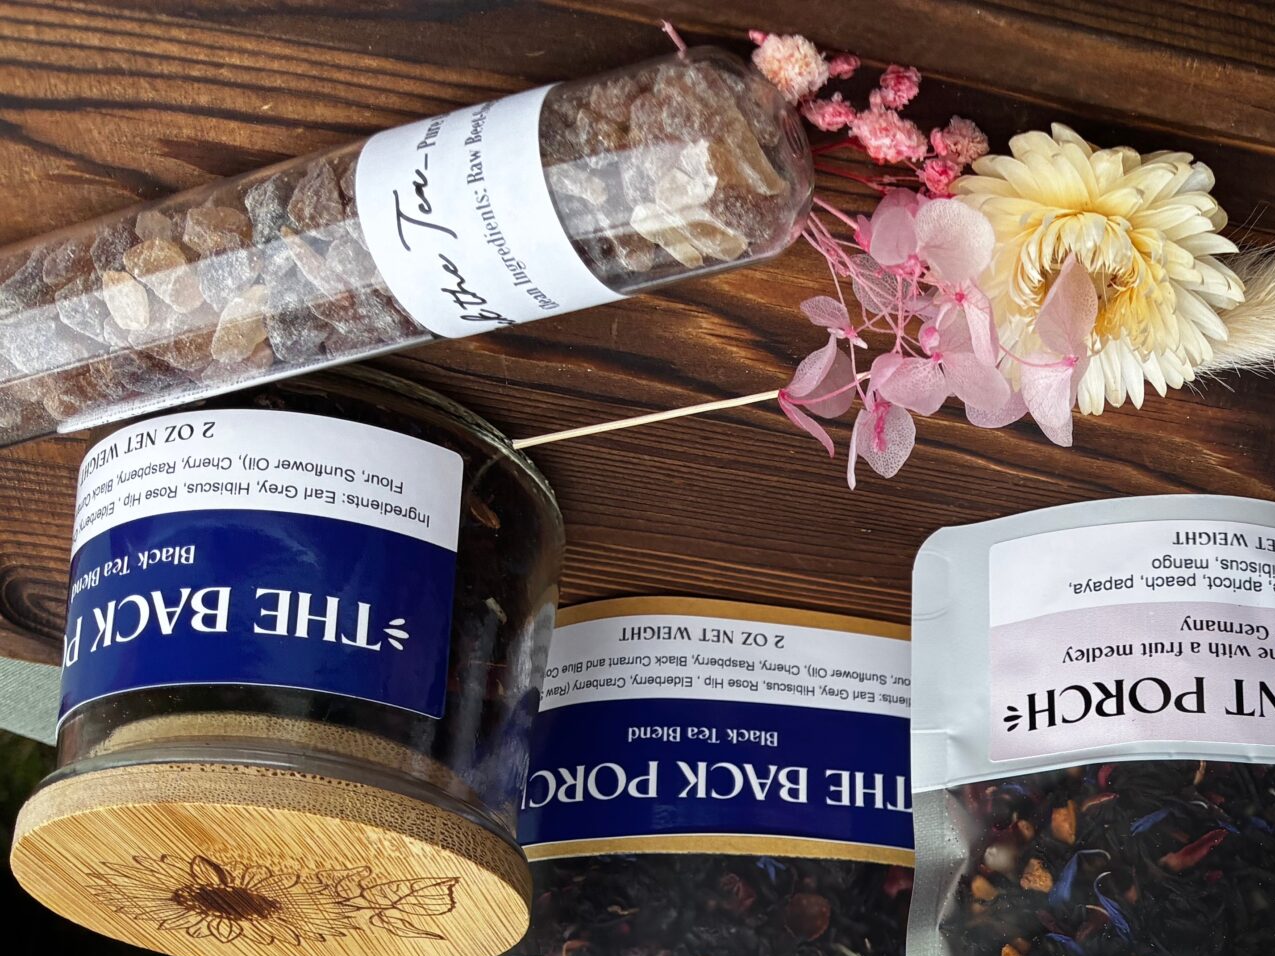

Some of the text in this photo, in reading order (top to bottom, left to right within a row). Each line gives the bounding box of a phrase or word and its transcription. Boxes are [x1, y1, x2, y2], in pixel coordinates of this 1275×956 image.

[466, 148, 485, 185] Raw
[392, 168, 459, 253] Tea
[473, 187, 533, 287] Ingredients:
[79, 421, 216, 486] 2 OZ NET WEIGHT
[92, 454, 404, 501] Flour, Sunflower Oil), Cherry, Raspberry, Black
[123, 480, 430, 528] Ingredients: Earl Grey, Hibiscus, Rose Hip
[1172, 530, 1248, 548] WEIGHT
[1151, 553, 1209, 571] mango
[70, 545, 196, 604] Black Tea Blend
[1067, 572, 1263, 596] apricot, peach, papaya,
[89, 585, 382, 653] THE BACK
[1180, 616, 1270, 641] Germany
[618, 625, 785, 649] 2 OZ NET WEIGHT
[1061, 644, 1134, 665] medley
[1140, 641, 1183, 658] fruit
[1189, 641, 1201, 655] a
[1208, 642, 1251, 660] with
[562, 654, 888, 685] Sunflower Oil), Cherry, Raspberry, Black Currant and Blue
[545, 682, 570, 698] (Raw
[572, 677, 627, 692] Cranberry
[630, 674, 693, 688] Elderberry,
[704, 676, 724, 689] Hip
[728, 678, 759, 691] Rose
[762, 680, 815, 697] Hibiscus,
[819, 685, 850, 700] Grey,
[852, 690, 876, 703] Earl
[1026, 675, 1206, 732] PORCH
[628, 726, 778, 747] Black Tea Blend
[675, 761, 913, 813] THE BACK
